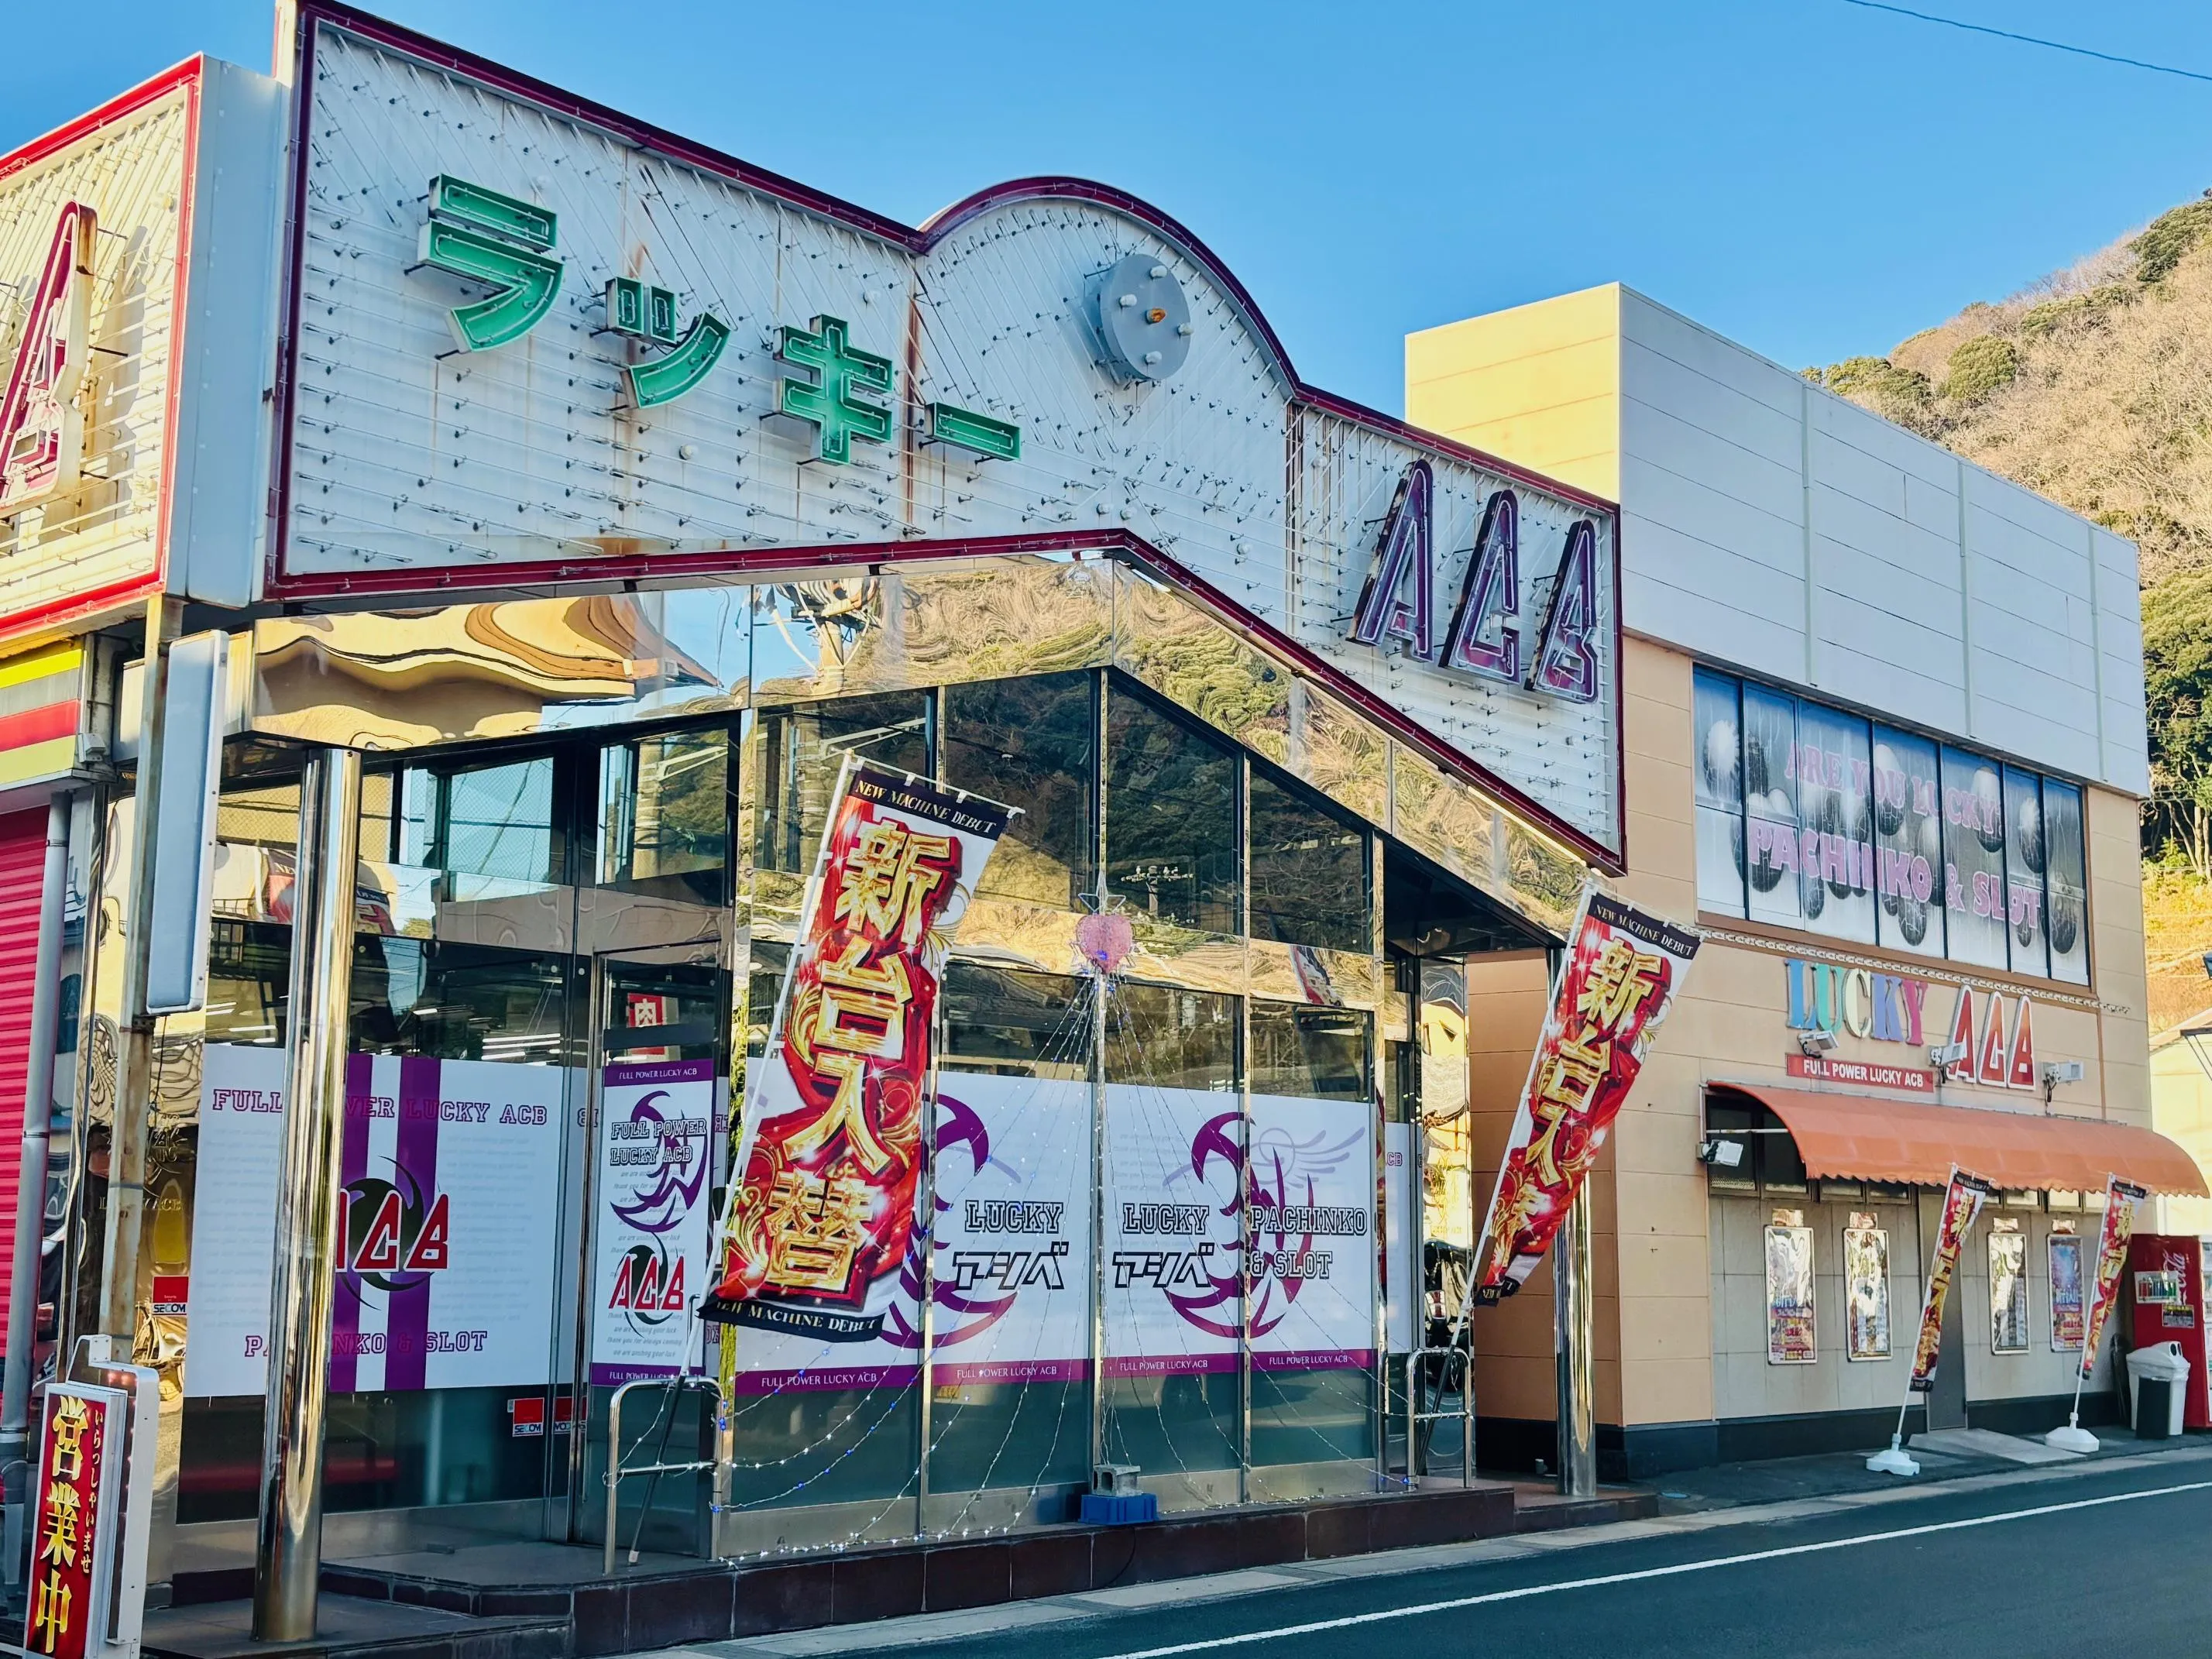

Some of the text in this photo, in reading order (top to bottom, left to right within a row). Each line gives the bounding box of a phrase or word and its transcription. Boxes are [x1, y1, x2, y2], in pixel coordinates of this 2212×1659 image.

[416, 173, 1022, 466] ラッキー
[1784, 742, 1843, 793] ARE
[1849, 758, 1906, 809] YOU
[855, 780, 997, 833] NEW MACHINE DEBUT
[1749, 816, 2042, 929] PACHINKO & SLOT
[1595, 904, 1695, 957] NEW MACHINE DEBUT
[1784, 958, 1929, 1046] LUCKY
[764, 819, 954, 1293] 新台入替
[635, 1070, 658, 1079] POWER
[659, 1069, 682, 1078] LUCKY
[682, 1067, 698, 1076] ACB
[1803, 1060, 1924, 1087] FULL POWER LUCKY ACB
[213, 1088, 283, 1113] FULL
[405, 1098, 490, 1122] LUCKY
[500, 1104, 548, 1125] ACB
[611, 1121, 650, 1140] FULL
[654, 1118, 707, 1138] POWER
[610, 1145, 693, 1166] LUCKY ACB
[965, 1200, 1063, 1234] LUCKY
[1122, 1203, 1210, 1235] LUCKY
[1250, 1205, 1368, 1236] PACHINKO
[1250, 1250, 1333, 1279] & SLOT
[153, 1304, 186, 1313] SECOM
[748, 1305, 823, 1328] MACHINE
[828, 1318, 878, 1333] DEBUT
[397, 1332, 414, 1353] &
[426, 1331, 488, 1352] SLOT
[957, 1366, 1057, 1379] FULL POWER LUCKY ACB
[1120, 1359, 1208, 1371] FULL POWER LUCKY ACB
[1269, 1354, 1348, 1365] FULL POWER LUCKY ACB
[761, 1373, 877, 1387] FULL POWER LUCKY ACB
[81, 1409, 105, 1574] いらっしゃいませ
[36, 1395, 88, 1654] 営業中
